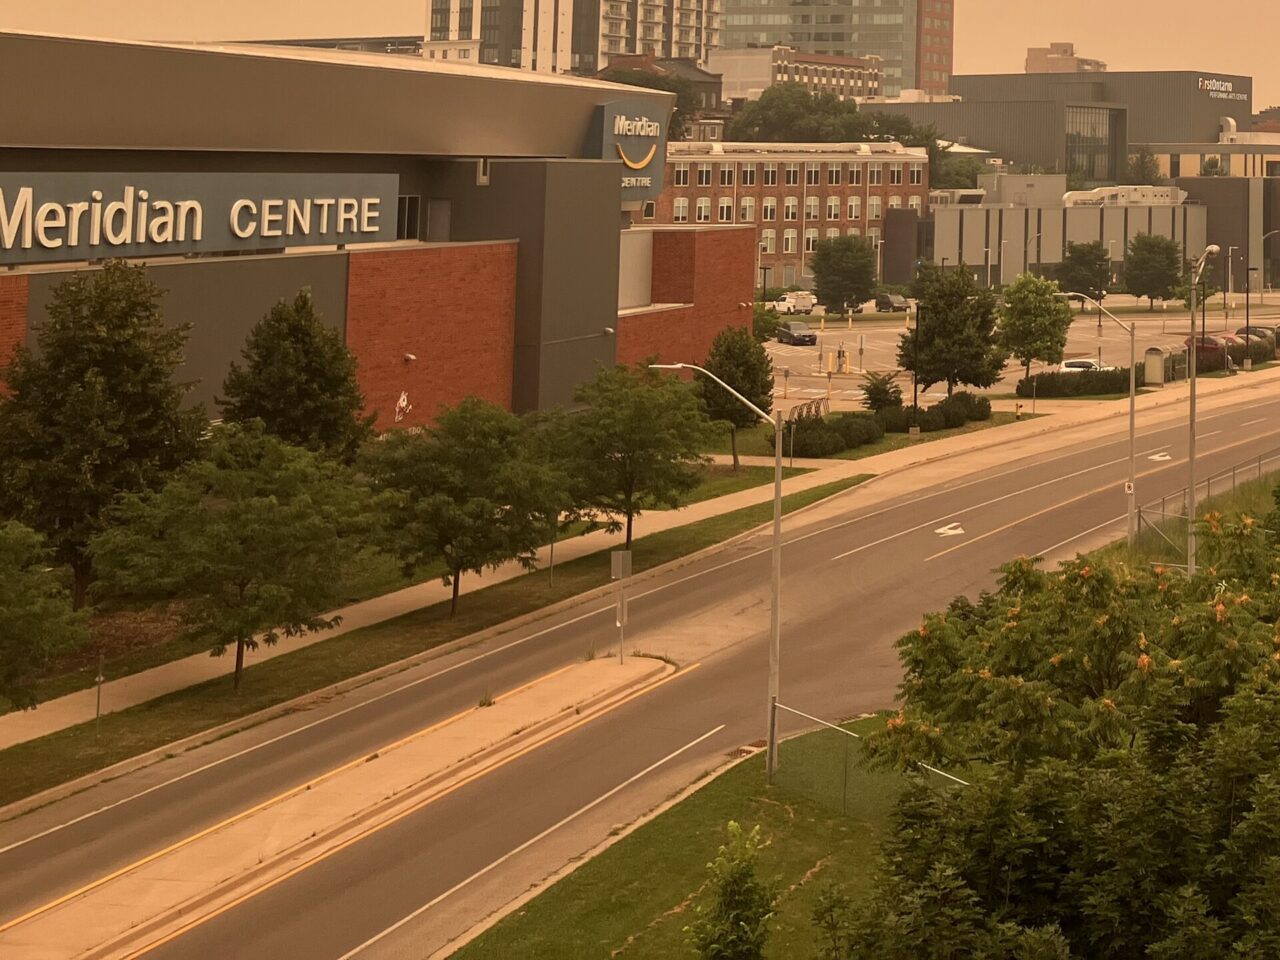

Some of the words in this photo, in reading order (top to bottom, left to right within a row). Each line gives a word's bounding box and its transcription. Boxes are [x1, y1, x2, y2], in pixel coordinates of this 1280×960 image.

[614, 115, 660, 136] Meridian
[0, 186, 203, 249] Meridian
[230, 197, 380, 238] CENTRE
